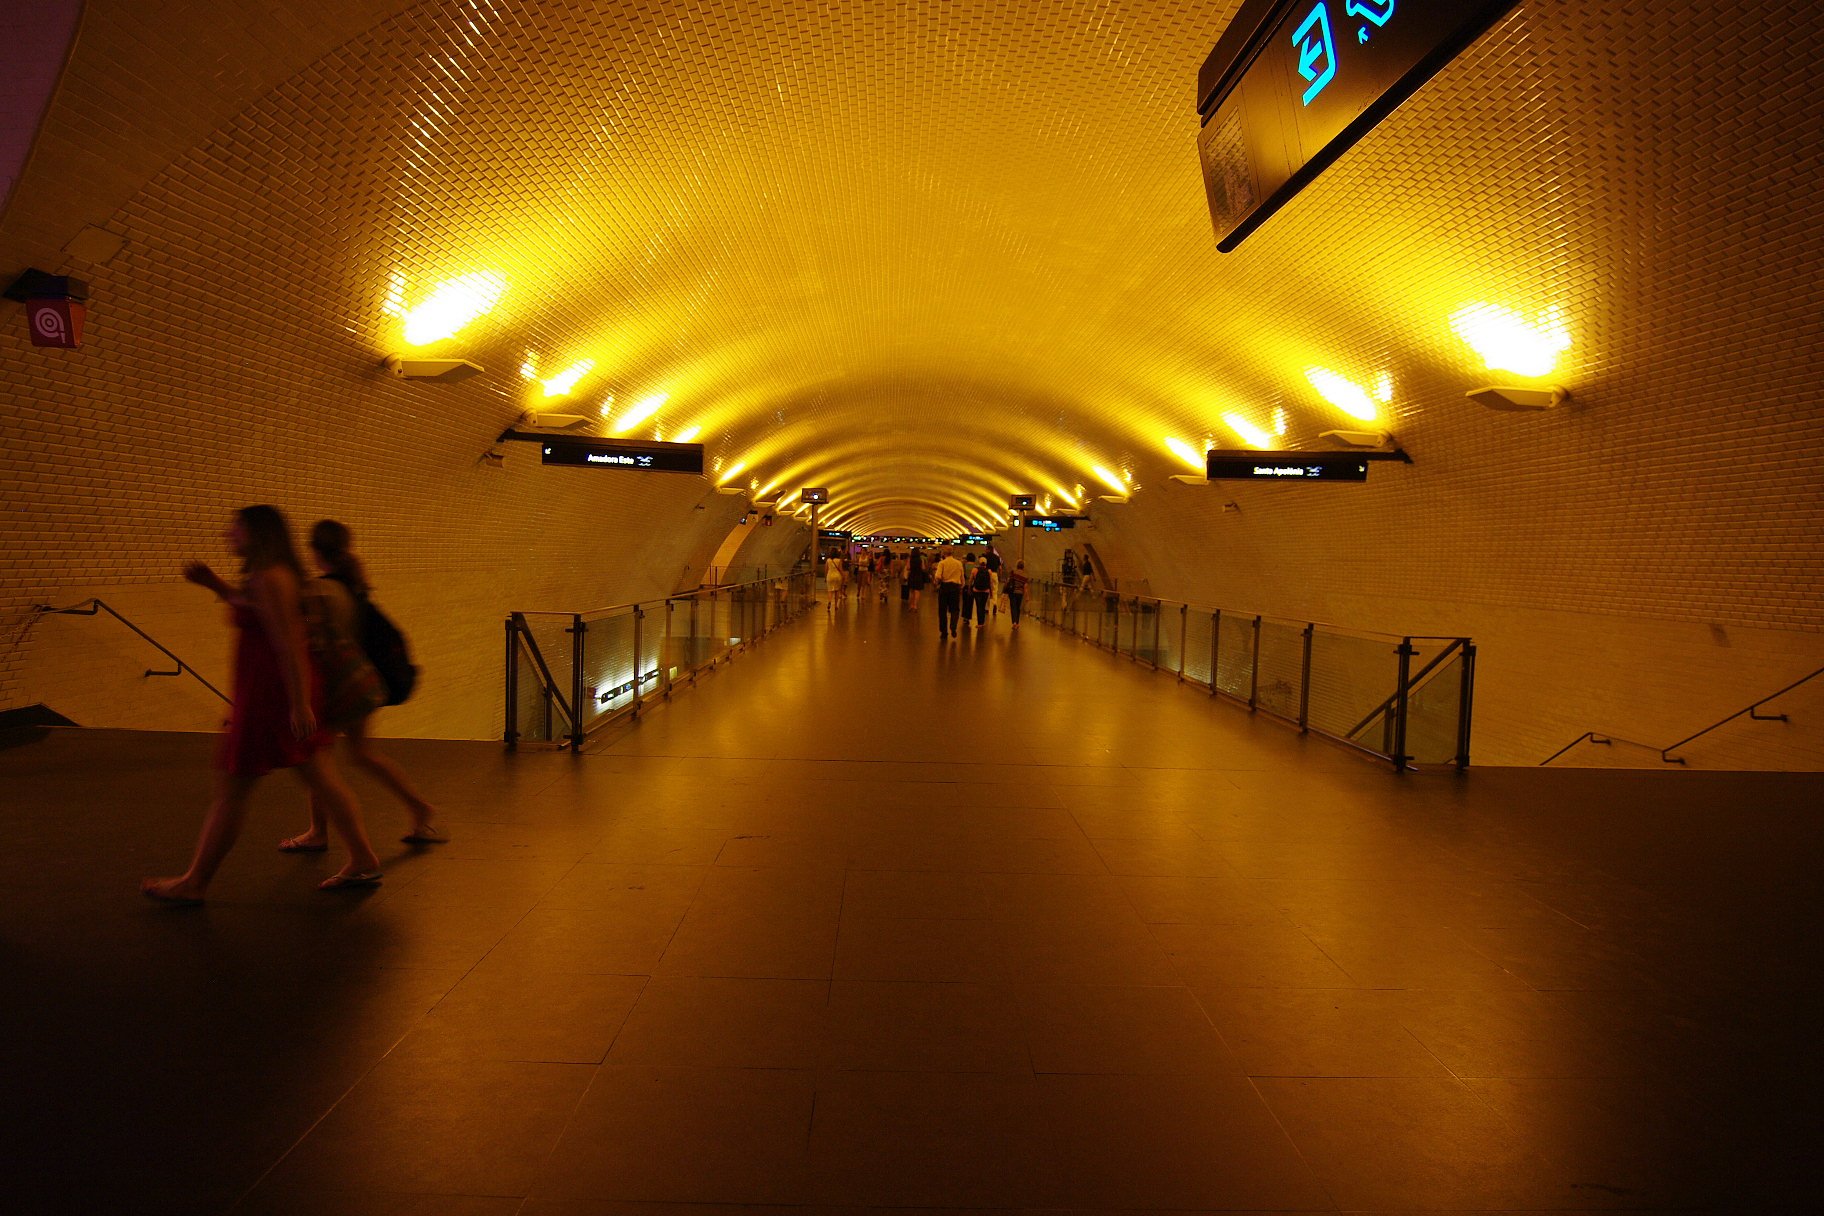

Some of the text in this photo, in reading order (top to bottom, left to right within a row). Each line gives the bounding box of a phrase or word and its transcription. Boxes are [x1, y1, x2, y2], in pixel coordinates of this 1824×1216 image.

[588, 453, 635, 465] Amadora Este
[1253, 466, 1274, 475] Santa
